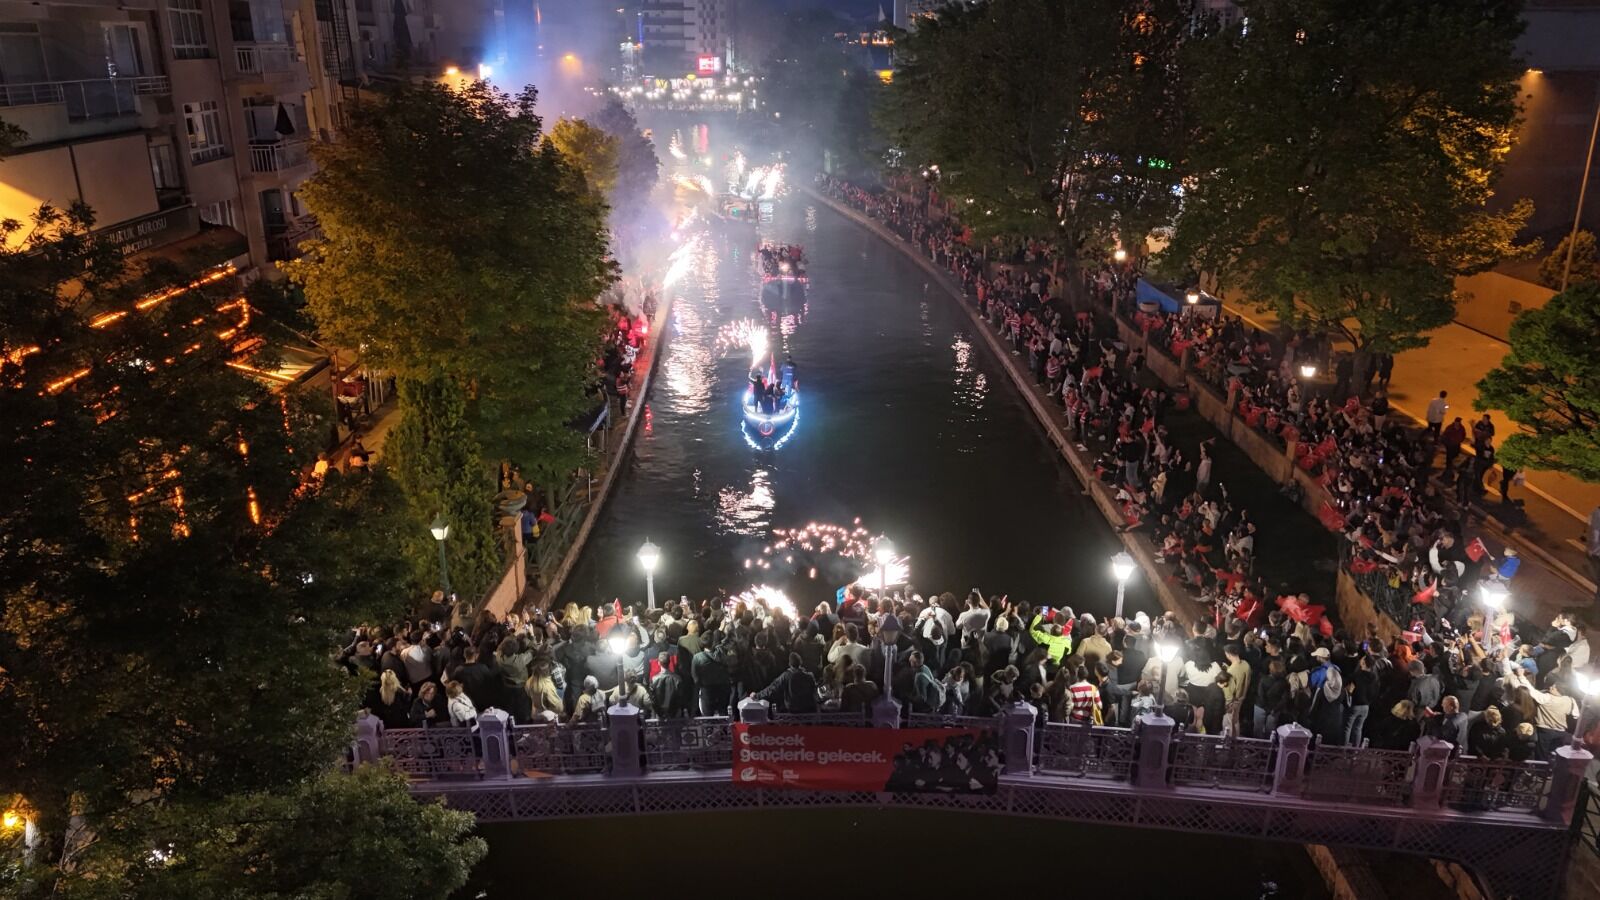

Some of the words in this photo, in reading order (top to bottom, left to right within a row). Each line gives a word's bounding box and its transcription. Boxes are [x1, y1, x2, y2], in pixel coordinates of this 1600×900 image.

[740, 732, 804, 746] Gelecek
[740, 748, 815, 763] gençlerle
[818, 750, 887, 765] gelecek.
